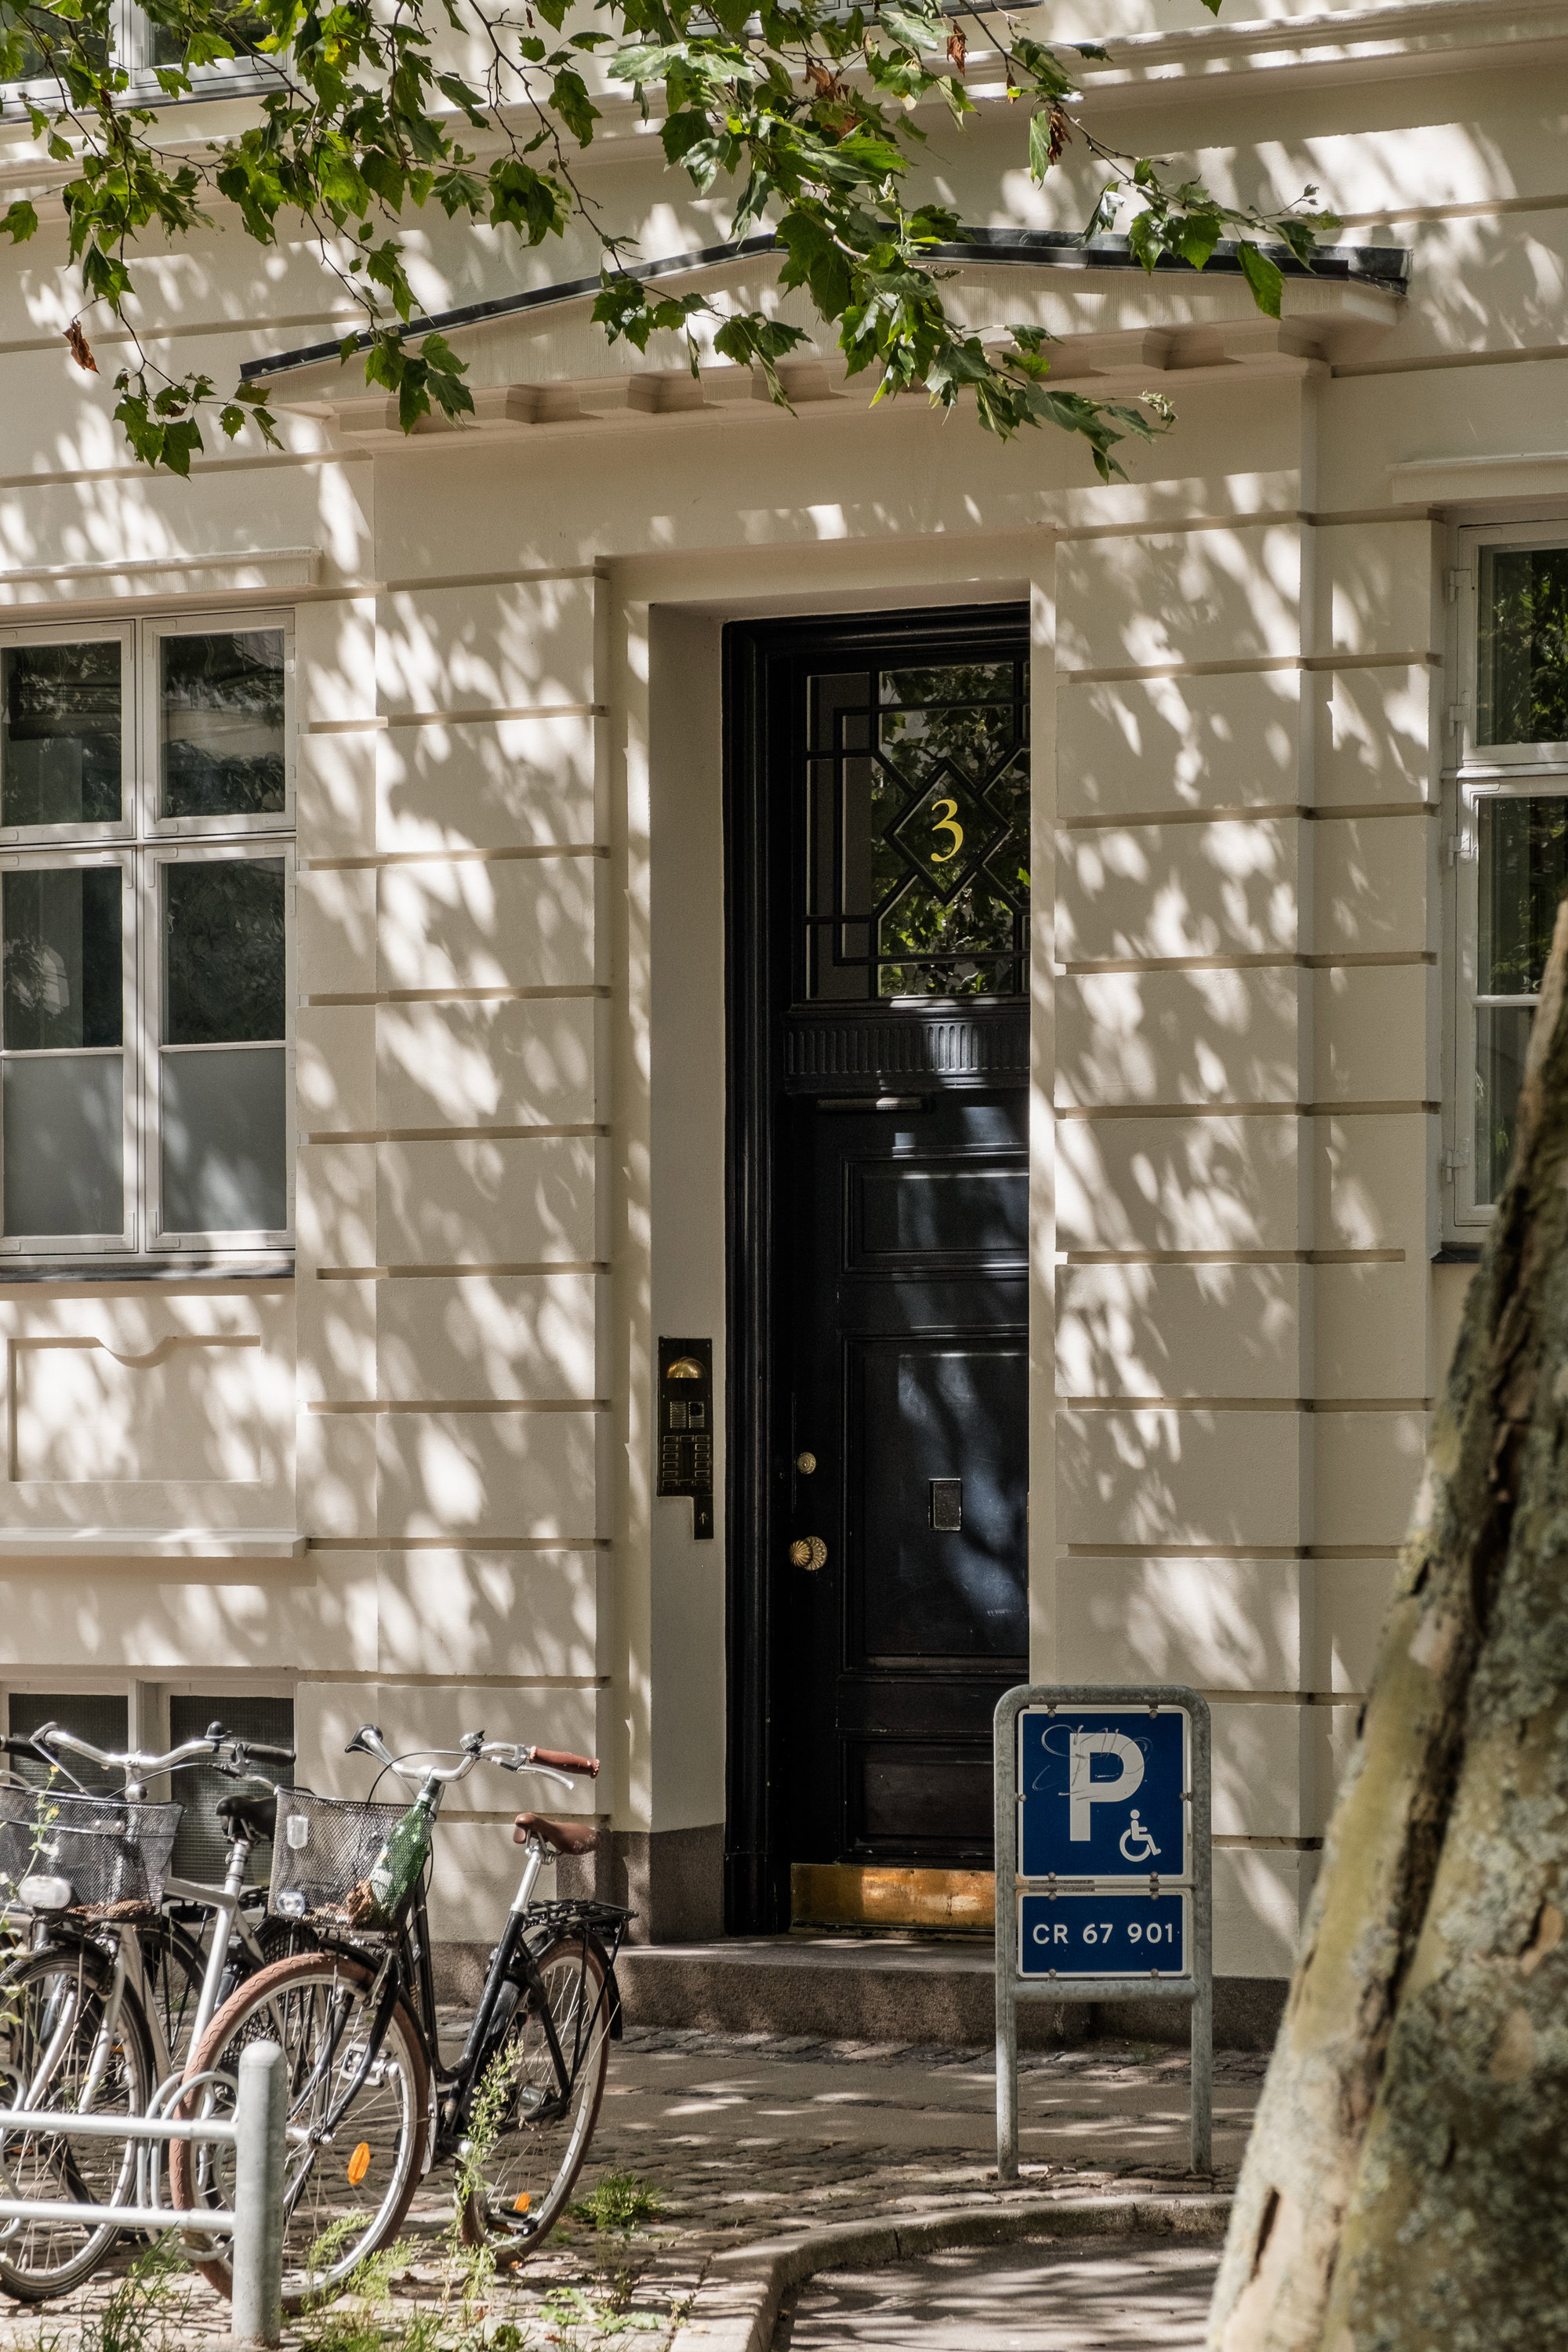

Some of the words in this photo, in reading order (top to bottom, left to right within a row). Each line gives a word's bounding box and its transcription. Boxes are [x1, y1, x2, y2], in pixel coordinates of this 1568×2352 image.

[931, 799, 964, 862] 3
[1070, 1733, 1145, 1841] P
[1033, 1924, 1069, 1944] CR
[1083, 1923, 1113, 1944] 67
[1127, 1923, 1173, 1944] 901
